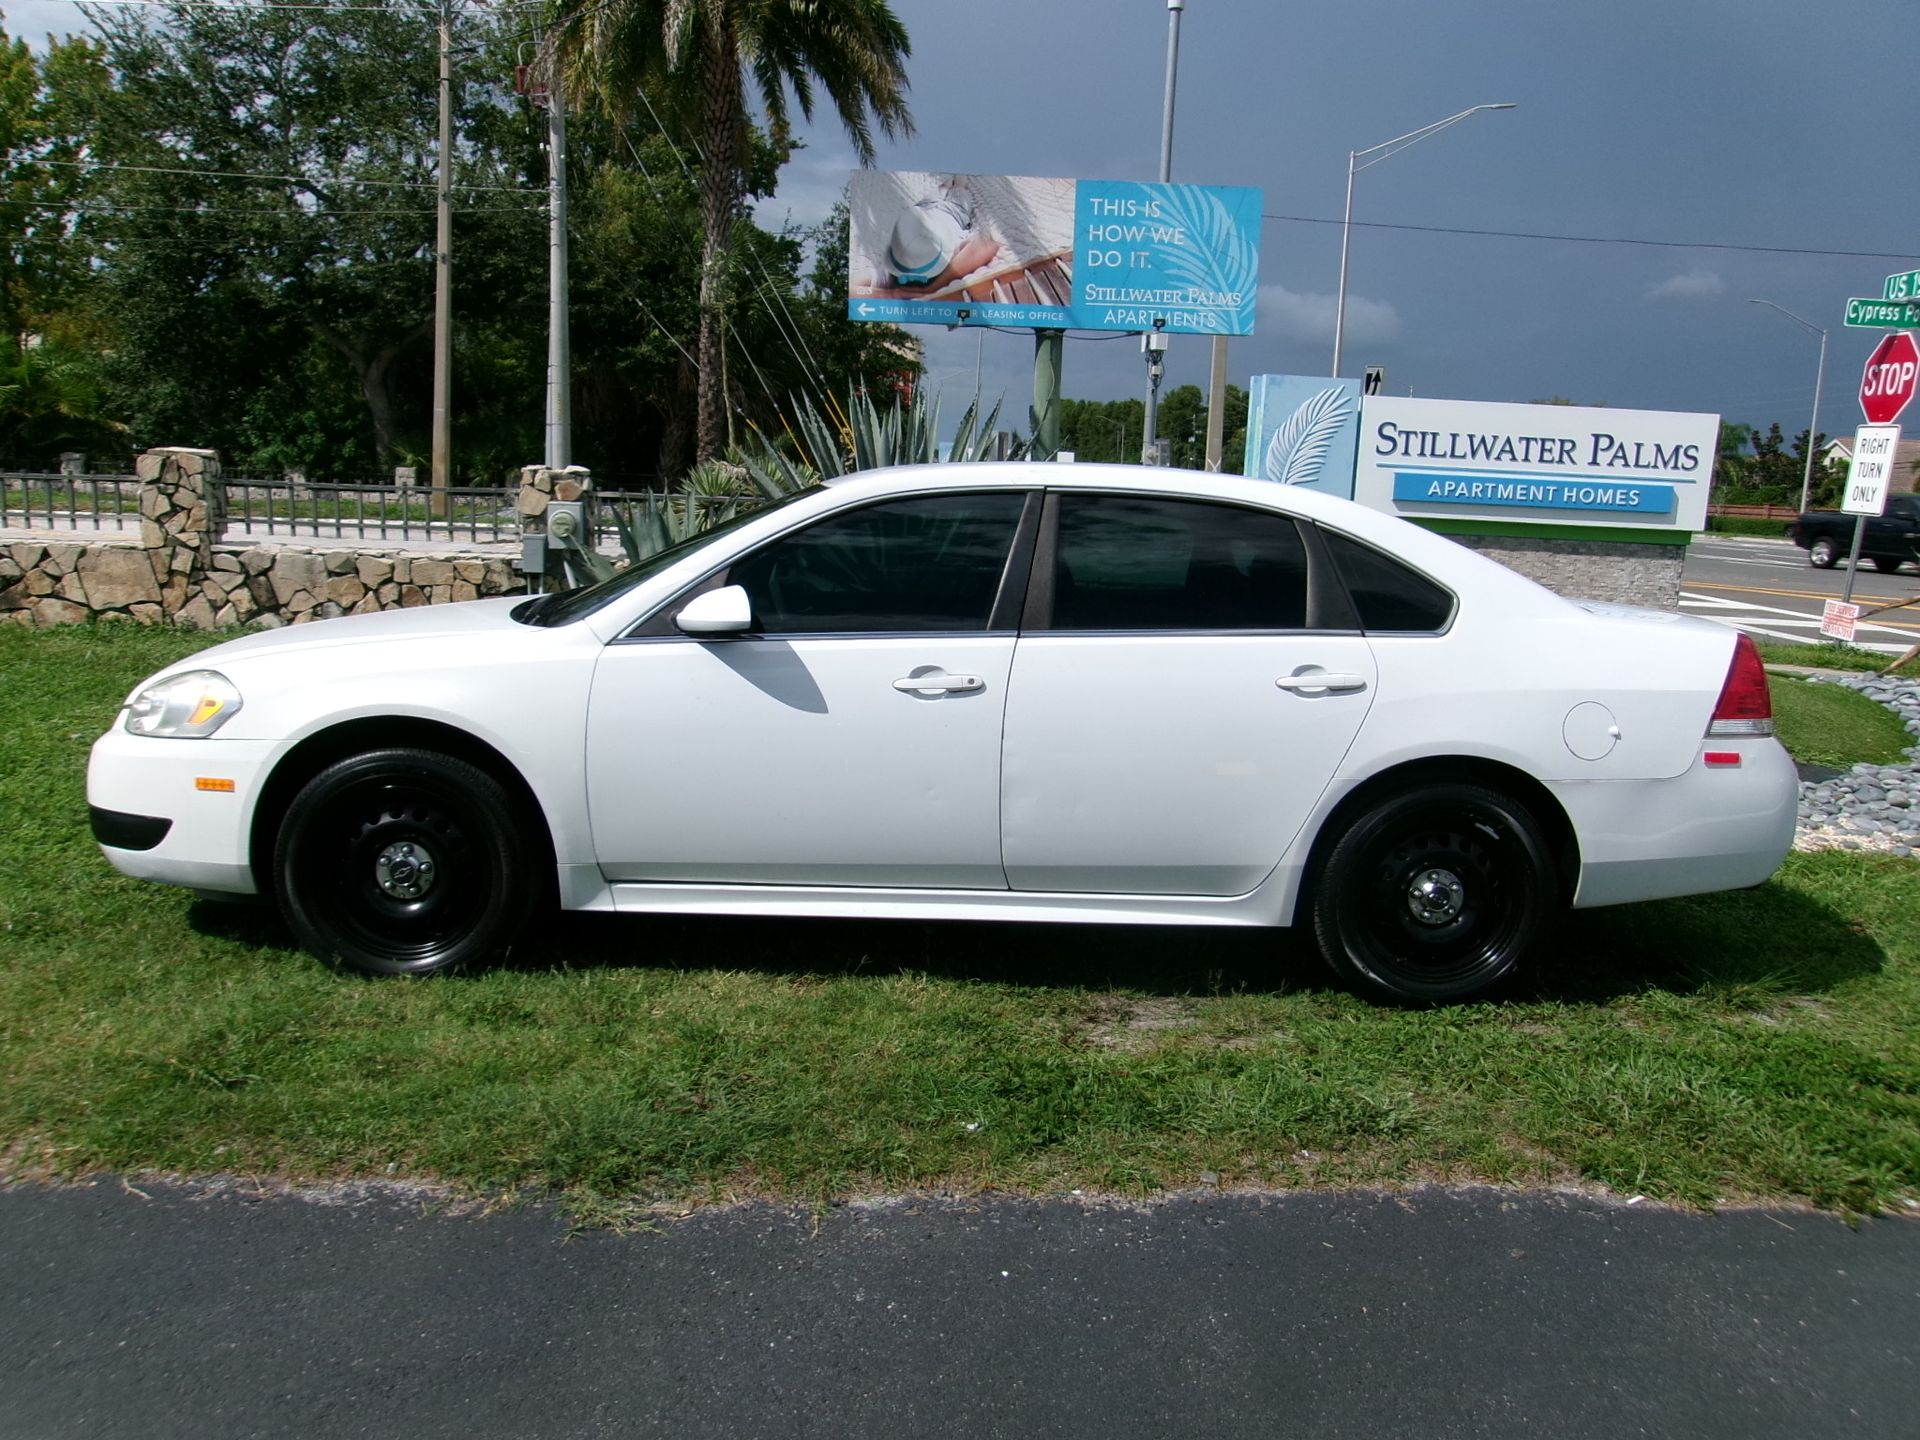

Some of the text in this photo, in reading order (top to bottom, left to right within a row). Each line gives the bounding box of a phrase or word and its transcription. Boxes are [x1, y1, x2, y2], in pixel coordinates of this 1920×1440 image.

[1090, 198, 1161, 218] THIS IS
[1089, 224, 1185, 245] HOW WE
[1088, 250, 1152, 269] DO IT.
[1085, 284, 1241, 306] STILLWATER PALMS
[1888, 275, 1908, 300] US
[880, 305, 908, 316] TURN
[912, 307, 934, 317] LEFT
[938, 307, 951, 317] TO
[982, 309, 1025, 320] LEASING
[1029, 311, 1064, 321] OFFICE
[1104, 309, 1216, 328] APARTMENTS
[1848, 300, 1900, 324] Cypress
[1864, 362, 1914, 397] STOP
[1376, 421, 1699, 472] STILLWATER PALMS
[1860, 438, 1891, 454] RIGHT
[1858, 462, 1884, 479] TURN
[1428, 480, 1641, 507] APARTMENT HOMES
[1852, 485, 1878, 503] ONLY
